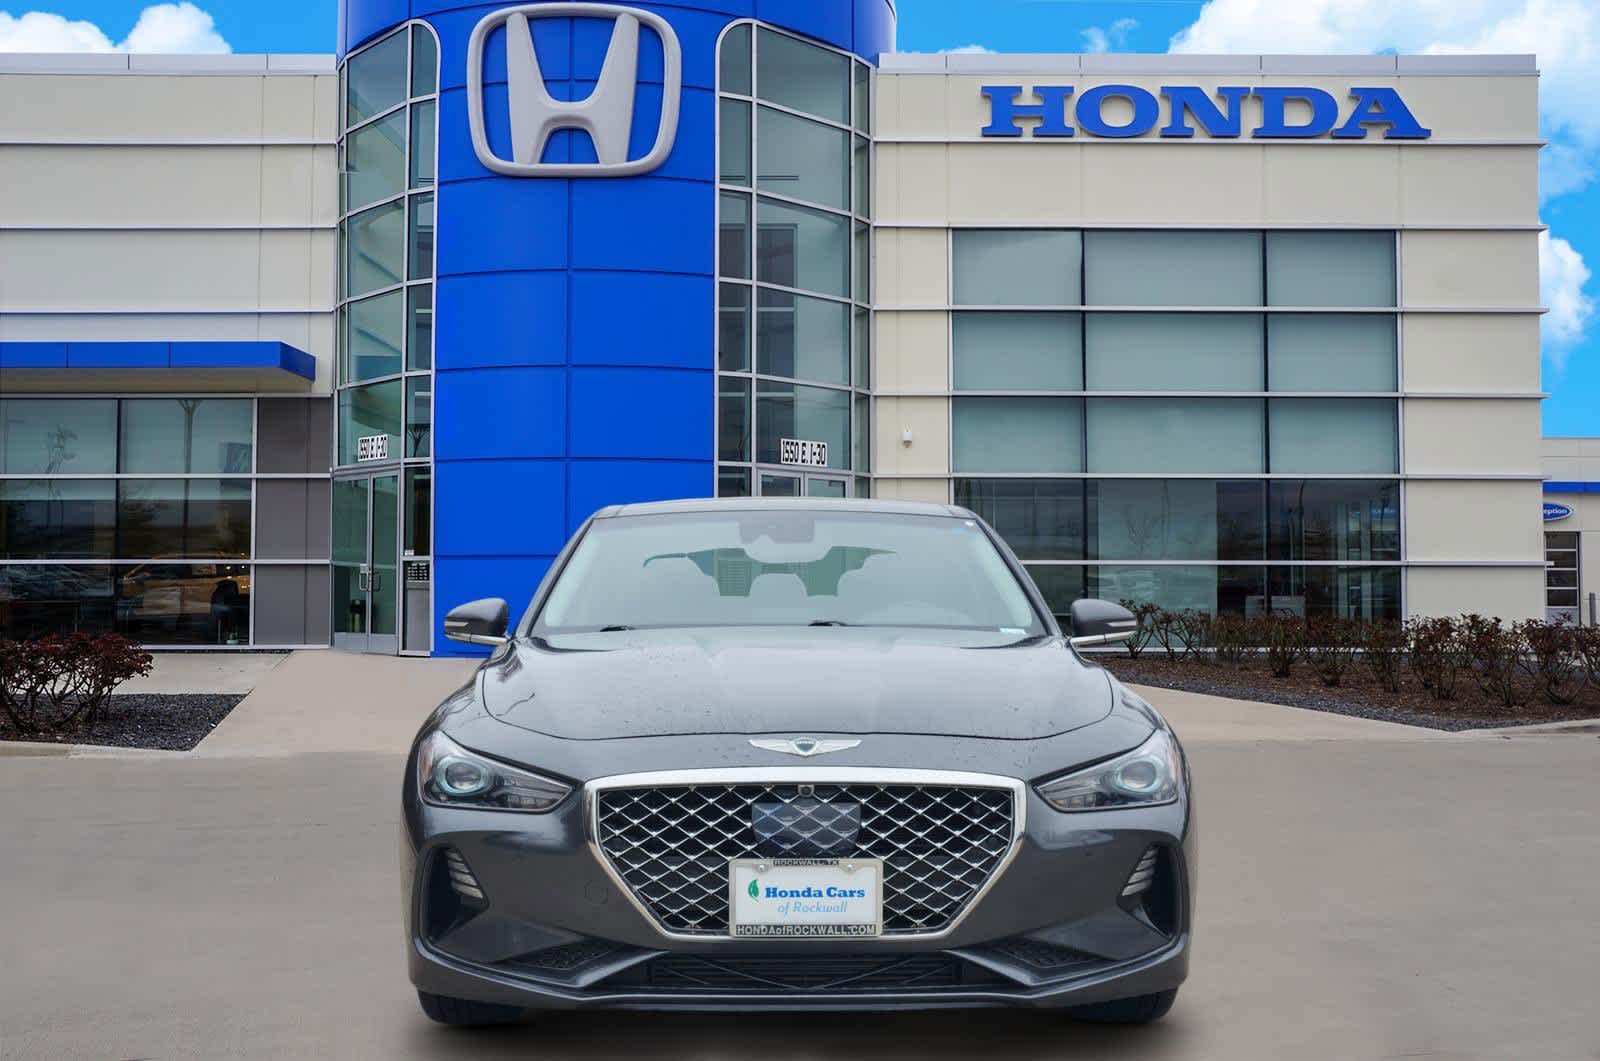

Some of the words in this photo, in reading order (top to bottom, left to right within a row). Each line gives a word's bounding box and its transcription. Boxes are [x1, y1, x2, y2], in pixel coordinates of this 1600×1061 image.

[980, 84, 1432, 139] HONDA
[782, 440, 800, 463] 1550
[810, 442, 826, 465] I-30
[1543, 507, 1568, 516] eption
[765, 886, 823, 898] Honda
[826, 886, 865, 898] Cars
[778, 902, 789, 917] of
[793, 901, 848, 913] Rockwall
